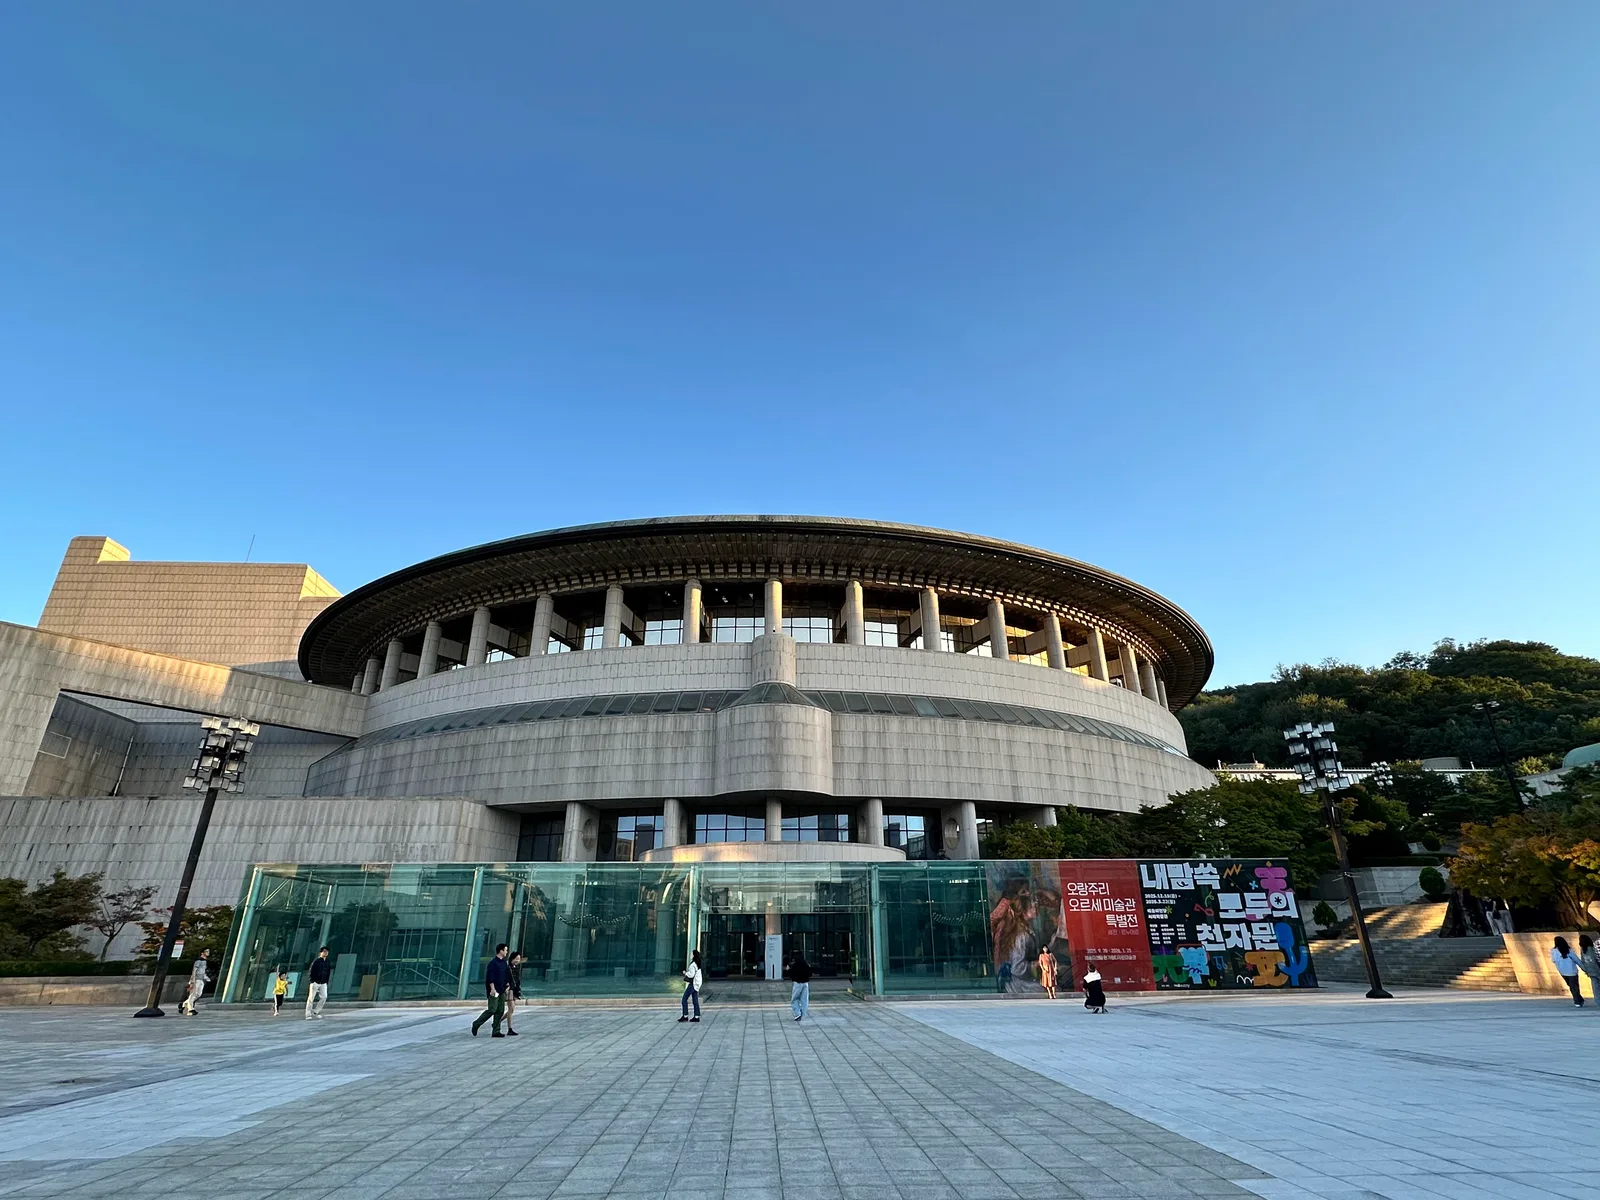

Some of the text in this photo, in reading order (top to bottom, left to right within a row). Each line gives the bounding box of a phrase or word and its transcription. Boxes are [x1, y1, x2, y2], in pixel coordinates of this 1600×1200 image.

[1067, 882, 1110, 896] 오랑주리
[1217, 891, 1299, 919] 모두의
[1105, 914, 1139, 928] 특별전
[1195, 922, 1280, 951] 천자문
